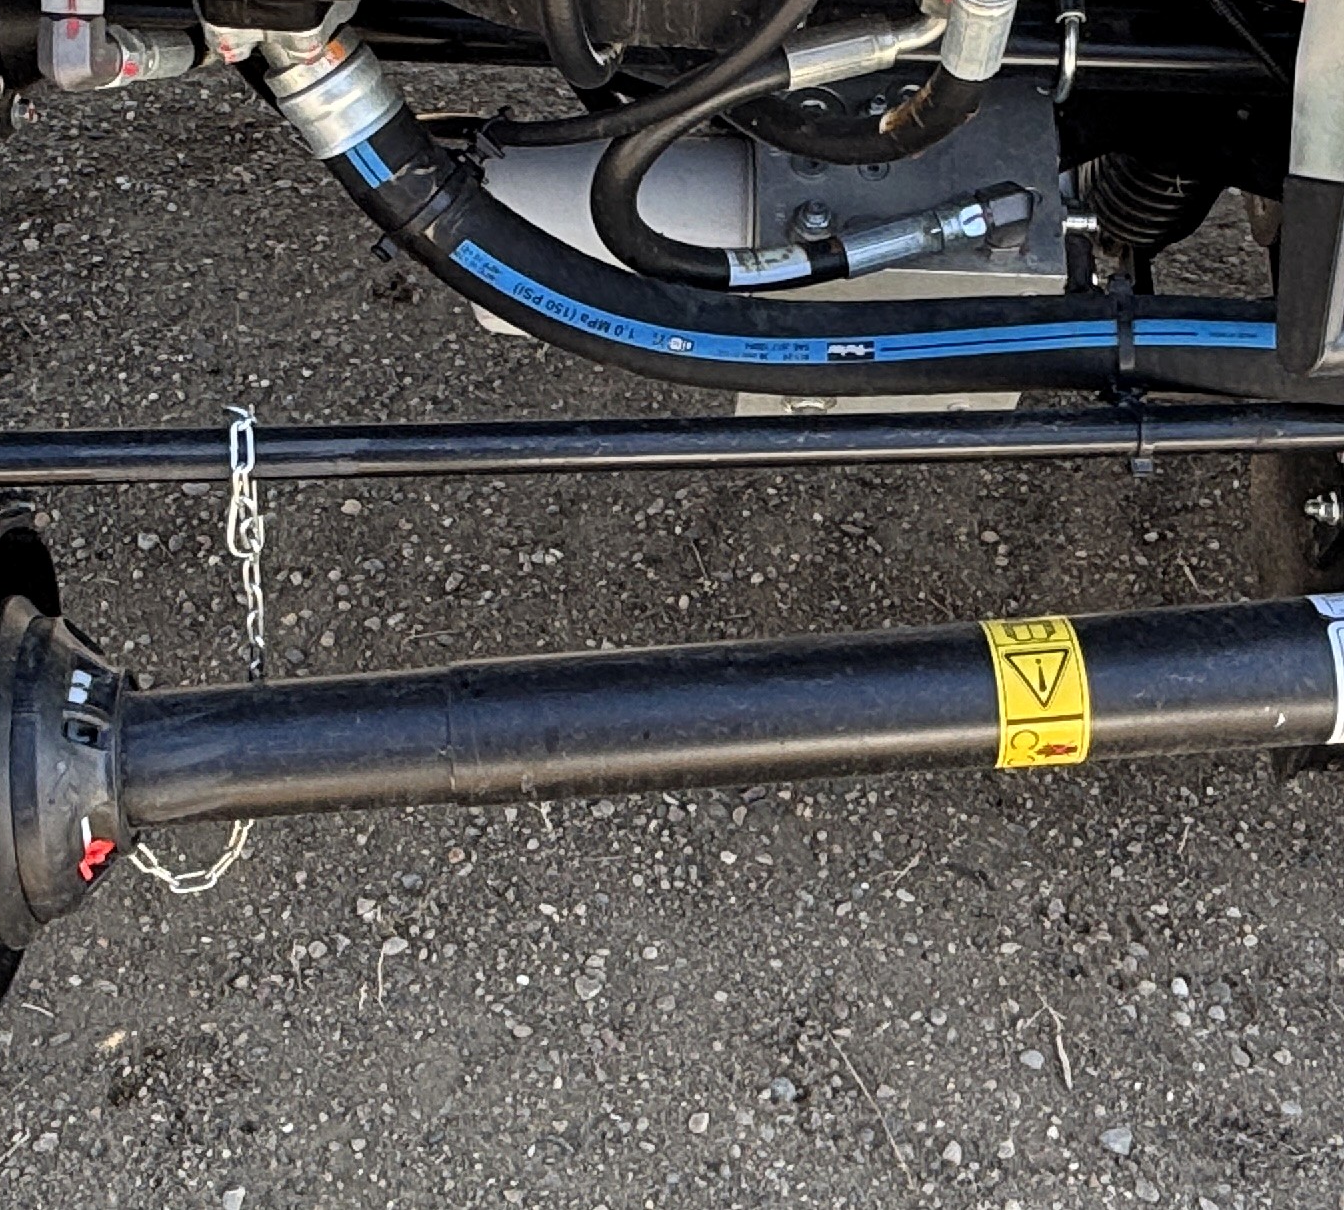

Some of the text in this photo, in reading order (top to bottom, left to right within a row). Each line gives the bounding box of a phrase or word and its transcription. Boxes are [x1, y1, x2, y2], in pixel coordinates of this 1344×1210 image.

[545, 299, 578, 322] (150
[579, 312, 612, 333] MPa
[613, 325, 636, 340] 1.0
